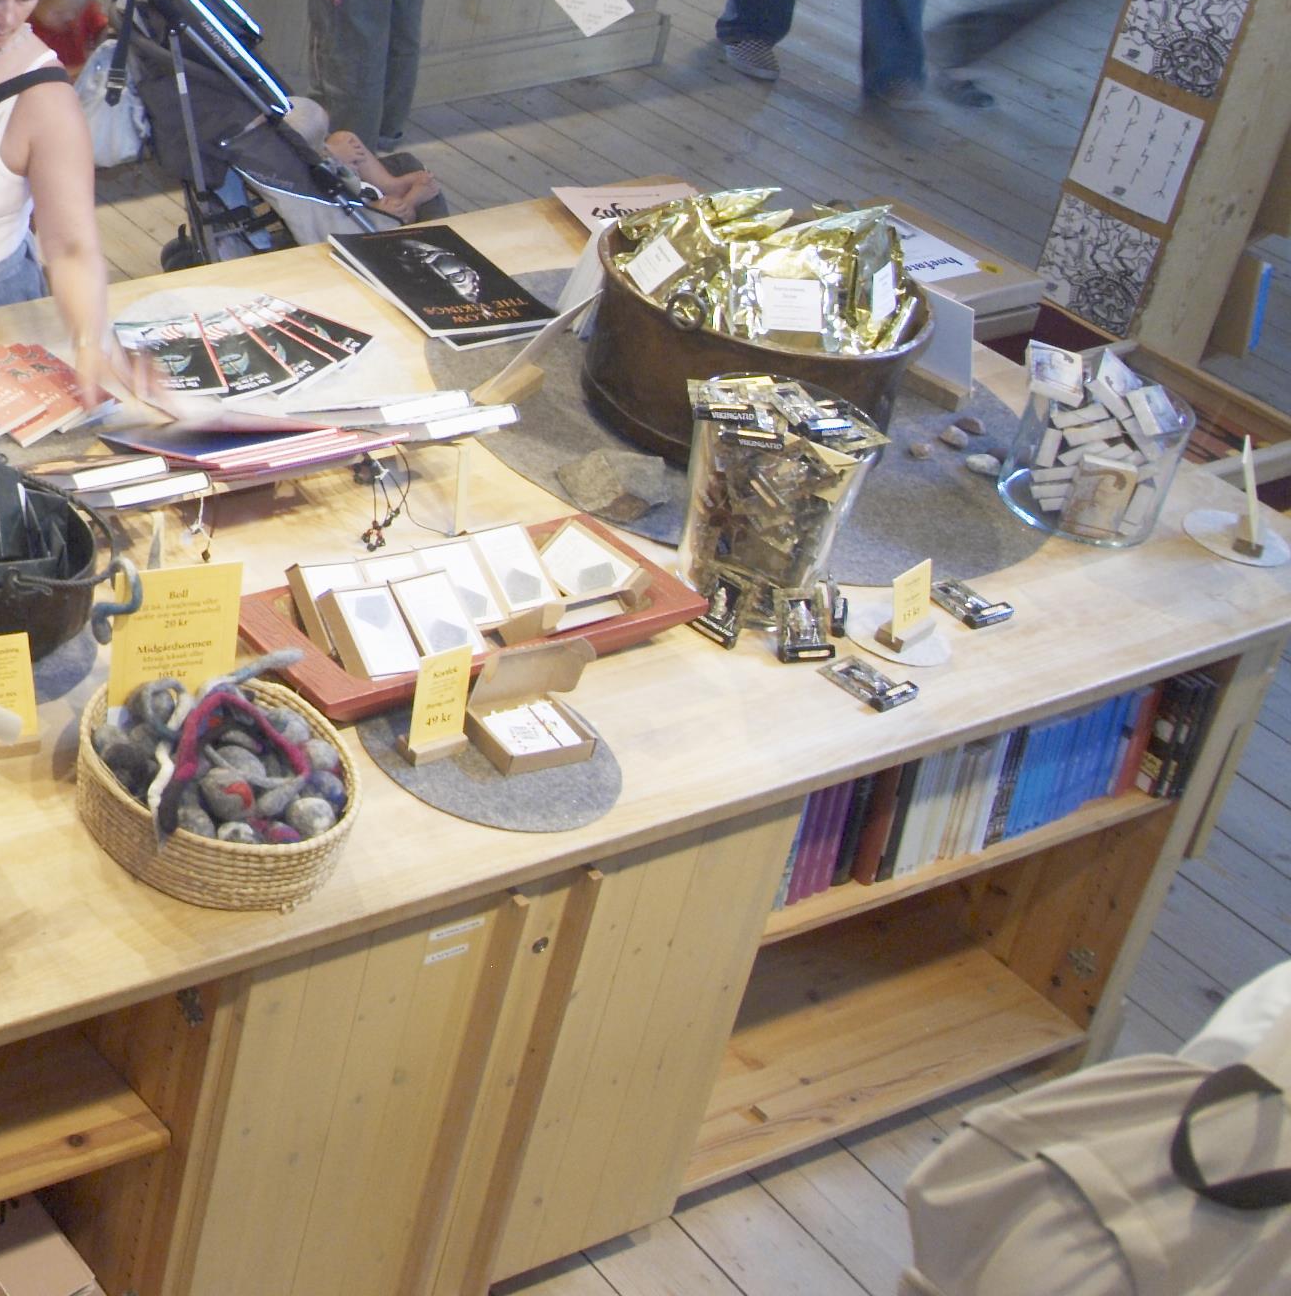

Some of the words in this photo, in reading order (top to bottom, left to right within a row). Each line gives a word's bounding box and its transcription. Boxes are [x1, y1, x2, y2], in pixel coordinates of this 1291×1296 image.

[492, 297, 529, 309] THE
[169, 589, 189, 601] Boll
[137, 639, 213, 655] Midgårdsormen
